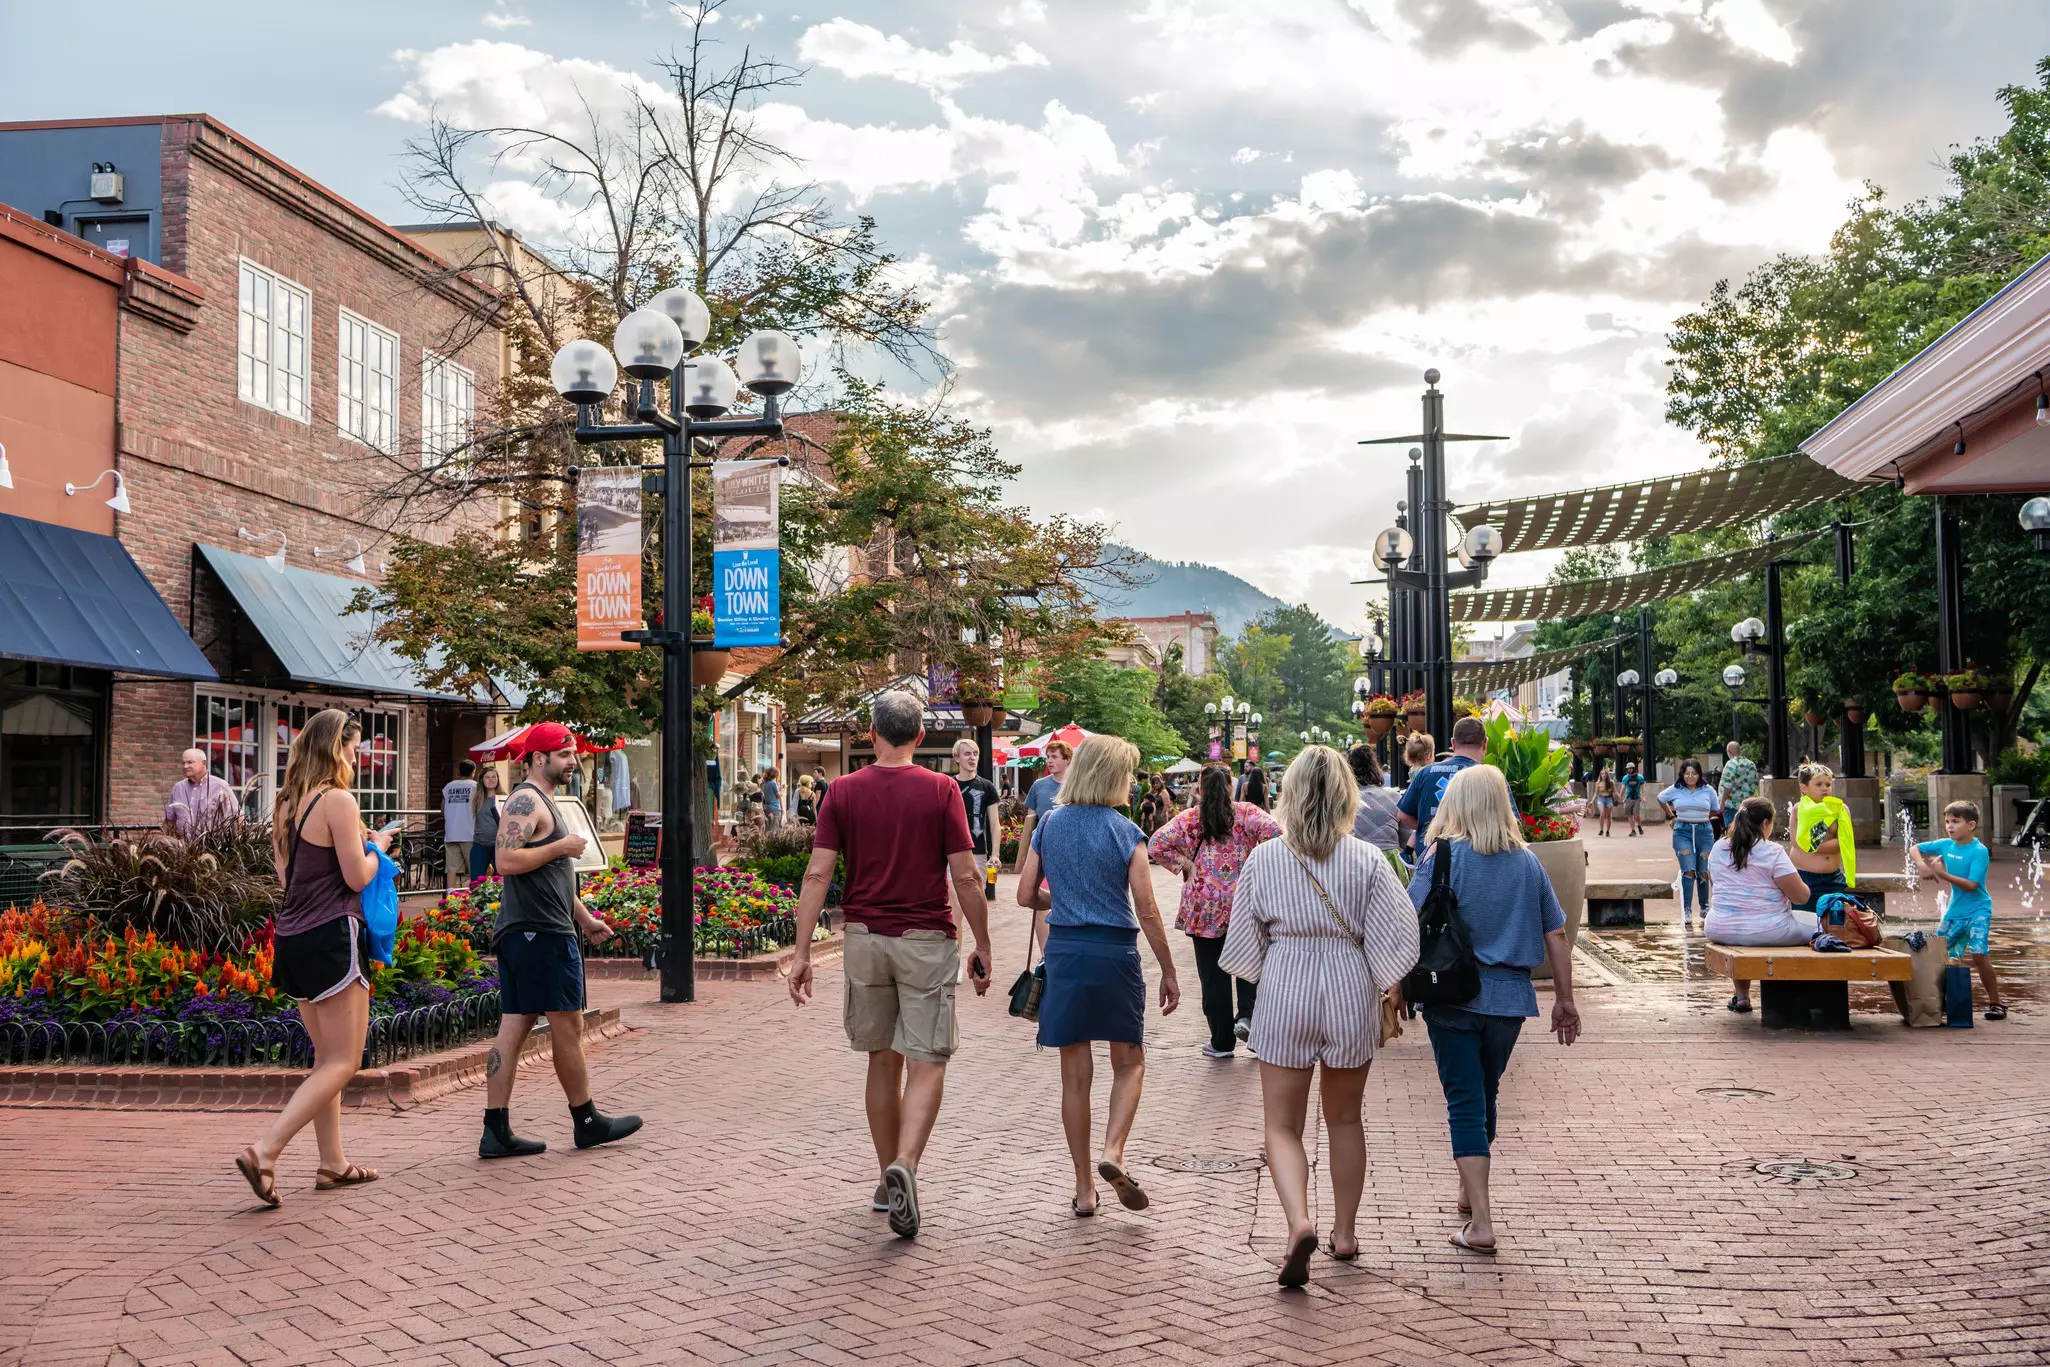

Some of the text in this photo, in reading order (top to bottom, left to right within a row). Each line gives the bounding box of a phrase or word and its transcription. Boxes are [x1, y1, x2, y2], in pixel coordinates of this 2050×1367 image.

[741, 473, 769, 487] WHITE
[587, 571, 631, 595] DOWN
[724, 567, 768, 591] DOWN
[587, 595, 631, 619] TOWN
[724, 591, 769, 615] TOWN
